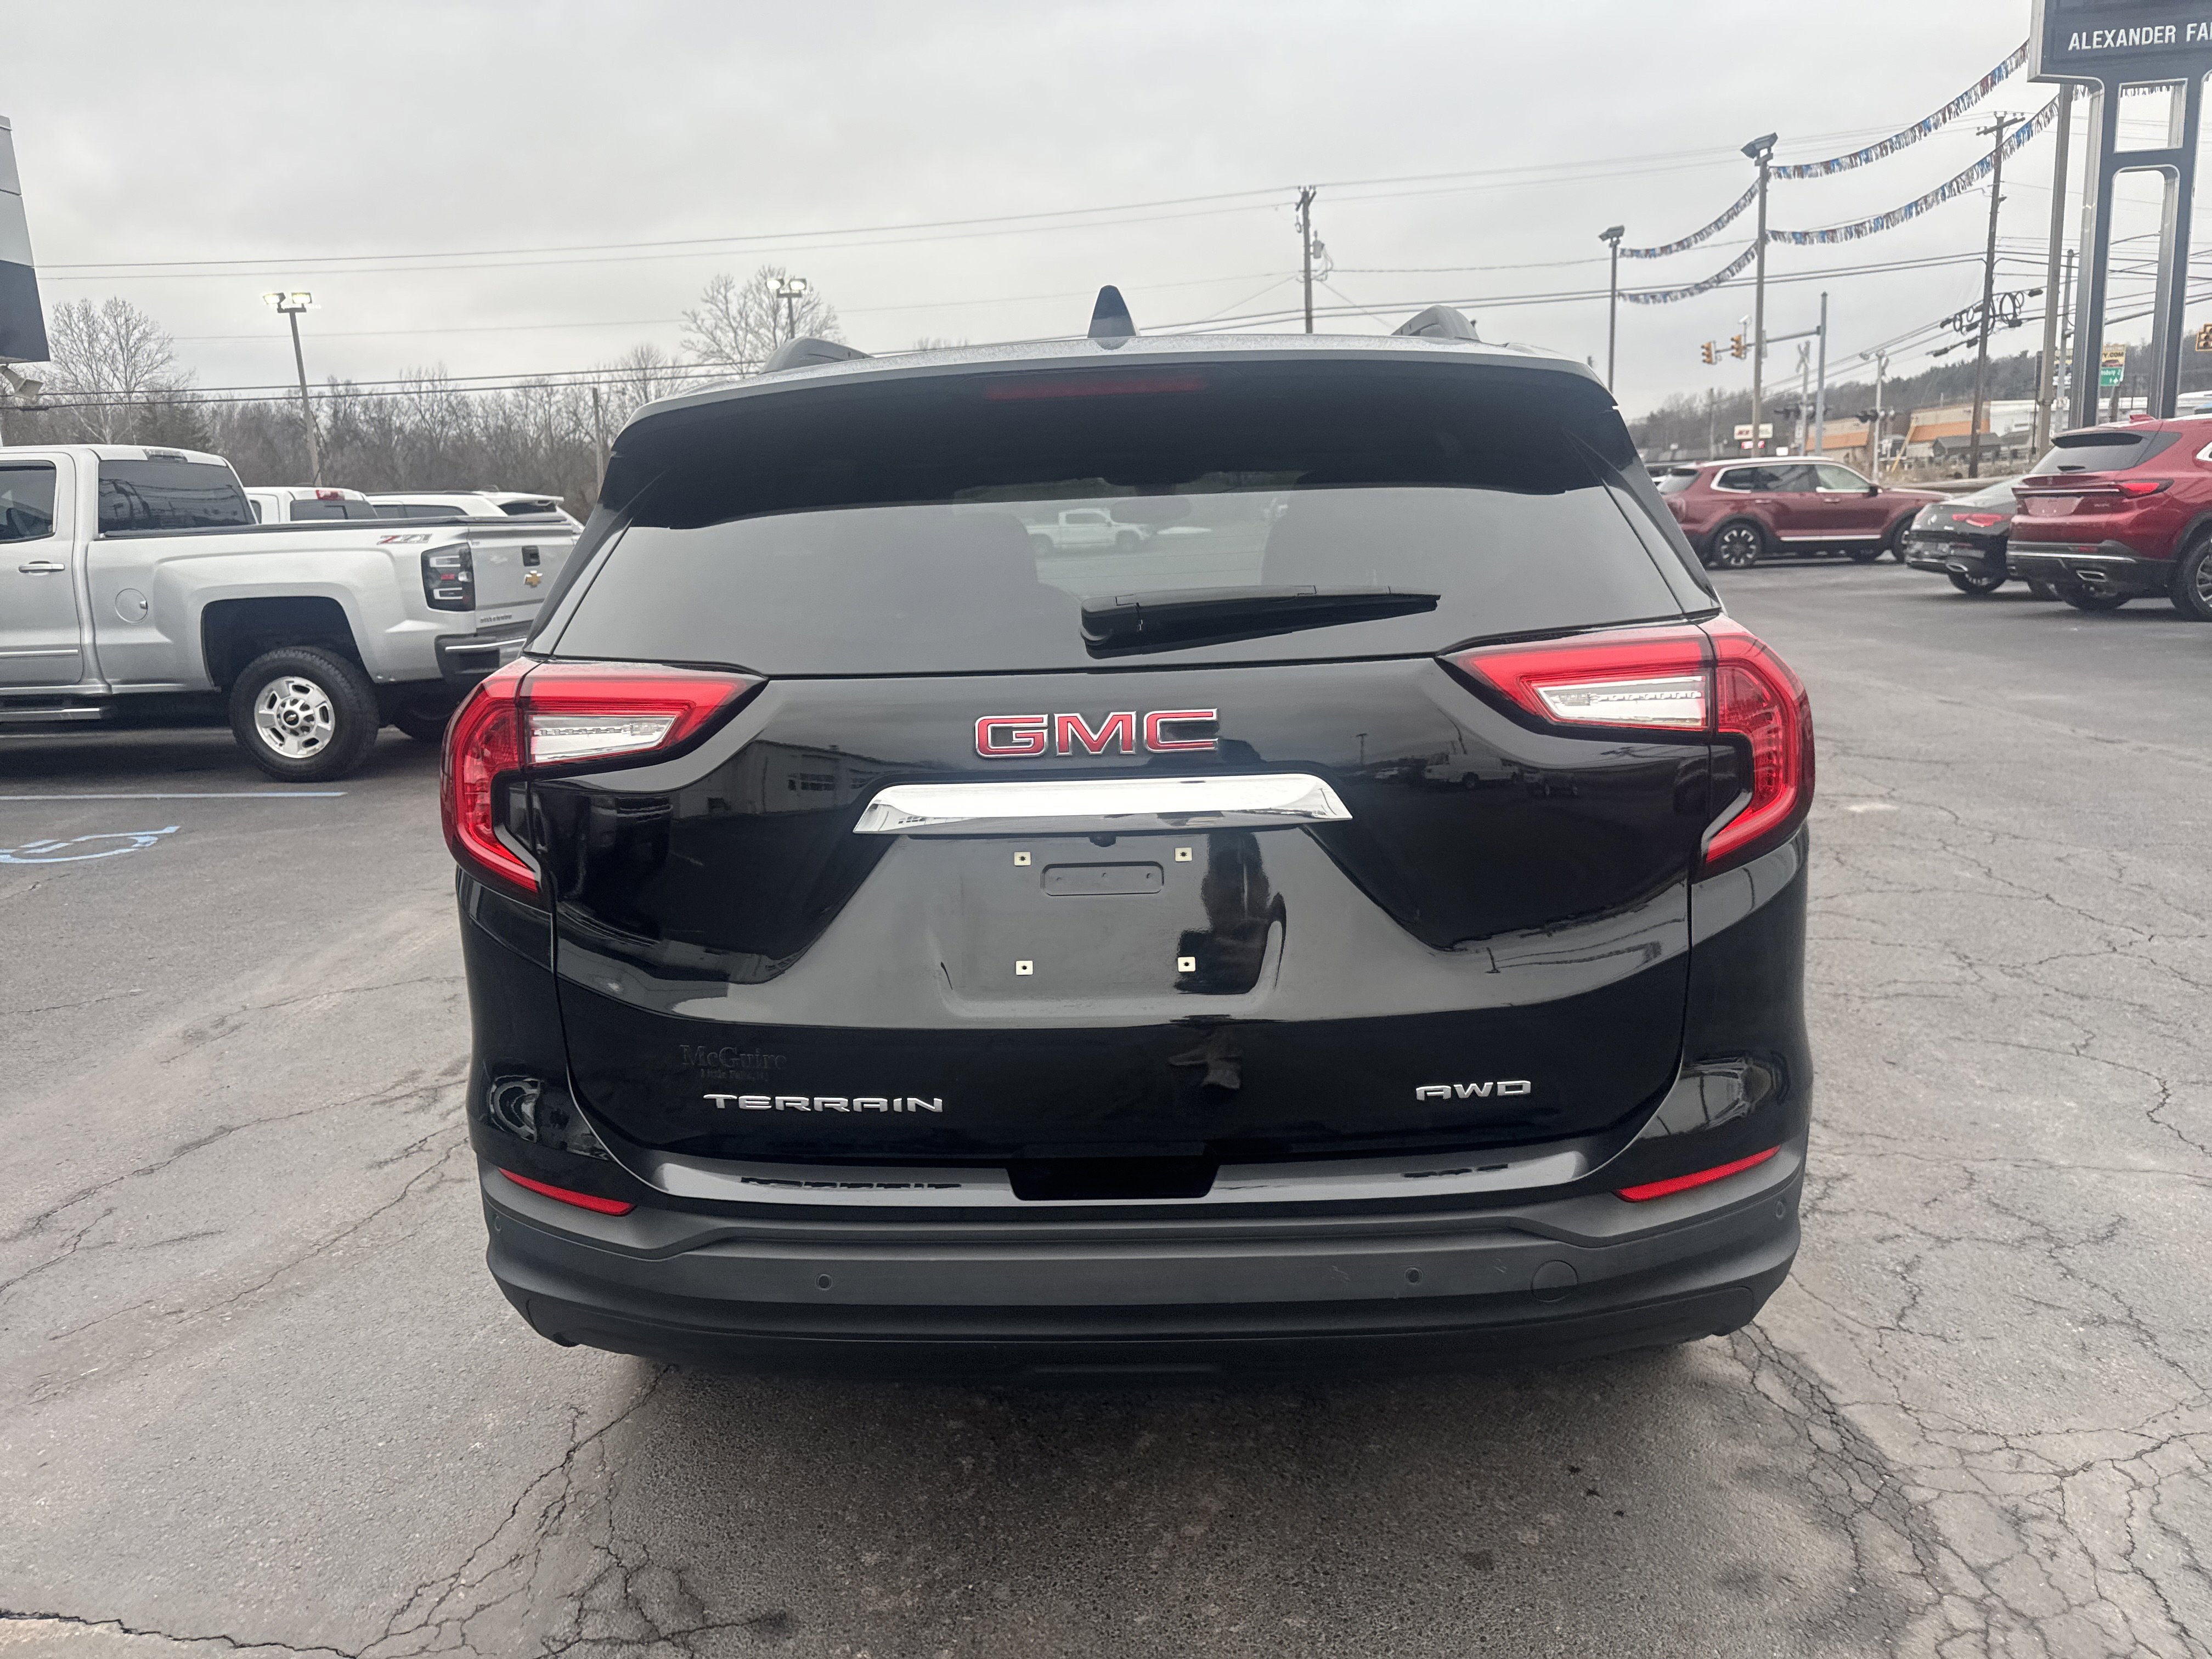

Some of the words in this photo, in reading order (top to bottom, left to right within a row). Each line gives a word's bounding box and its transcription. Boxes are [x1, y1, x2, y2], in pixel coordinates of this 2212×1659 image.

[2067, 25, 2176, 52] ALEXANDER
[2186, 22, 2212, 42] FA
[376, 533, 433, 546] Z71
[974, 708, 1219, 758] GMC
[679, 1044, 787, 1070] McGuire
[703, 1093, 944, 1113] TERRAIN
[1415, 1080, 1532, 1102] AWD
